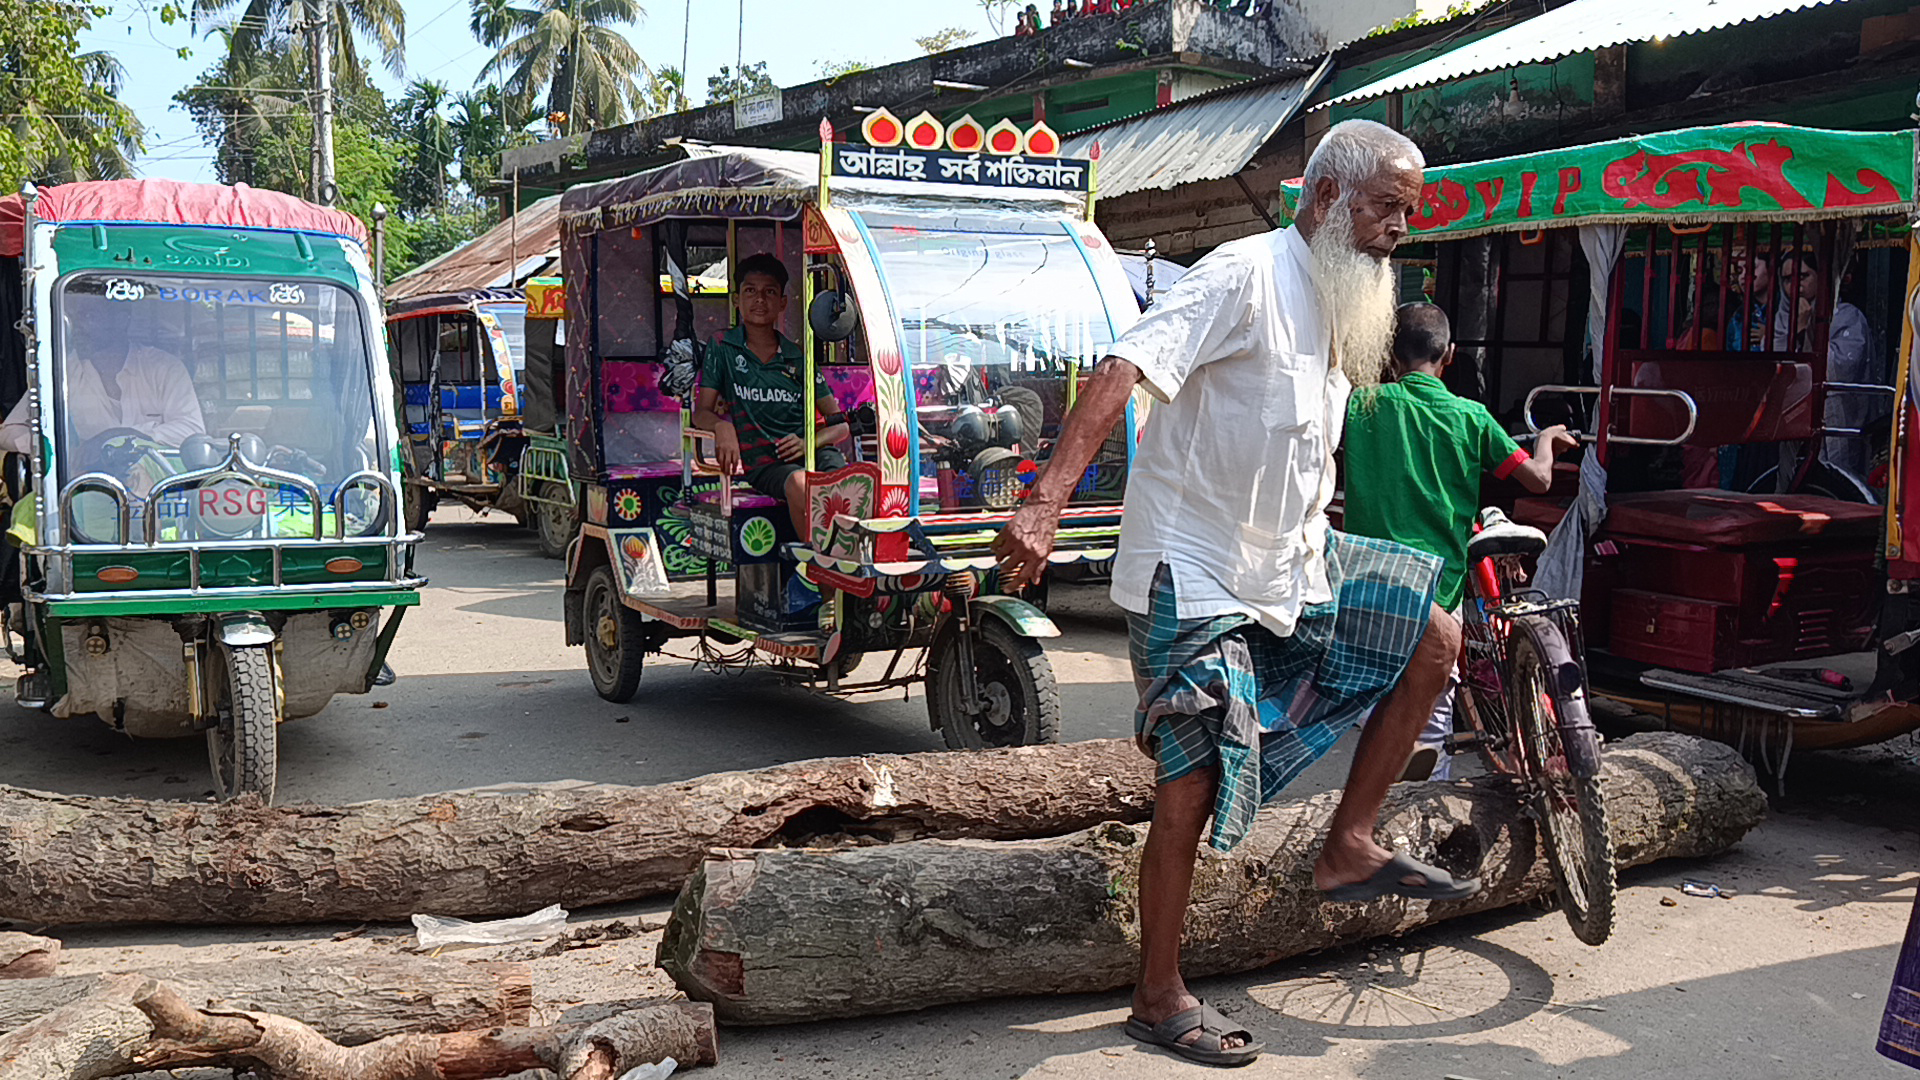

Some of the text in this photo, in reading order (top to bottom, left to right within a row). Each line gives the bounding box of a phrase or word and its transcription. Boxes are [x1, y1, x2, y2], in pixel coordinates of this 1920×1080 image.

[938, 153, 981, 182] সর্ব
[984, 156, 1083, 188] শক্তিমান
[160, 286, 267, 304] BORAK
[200, 488, 266, 516] RSG
